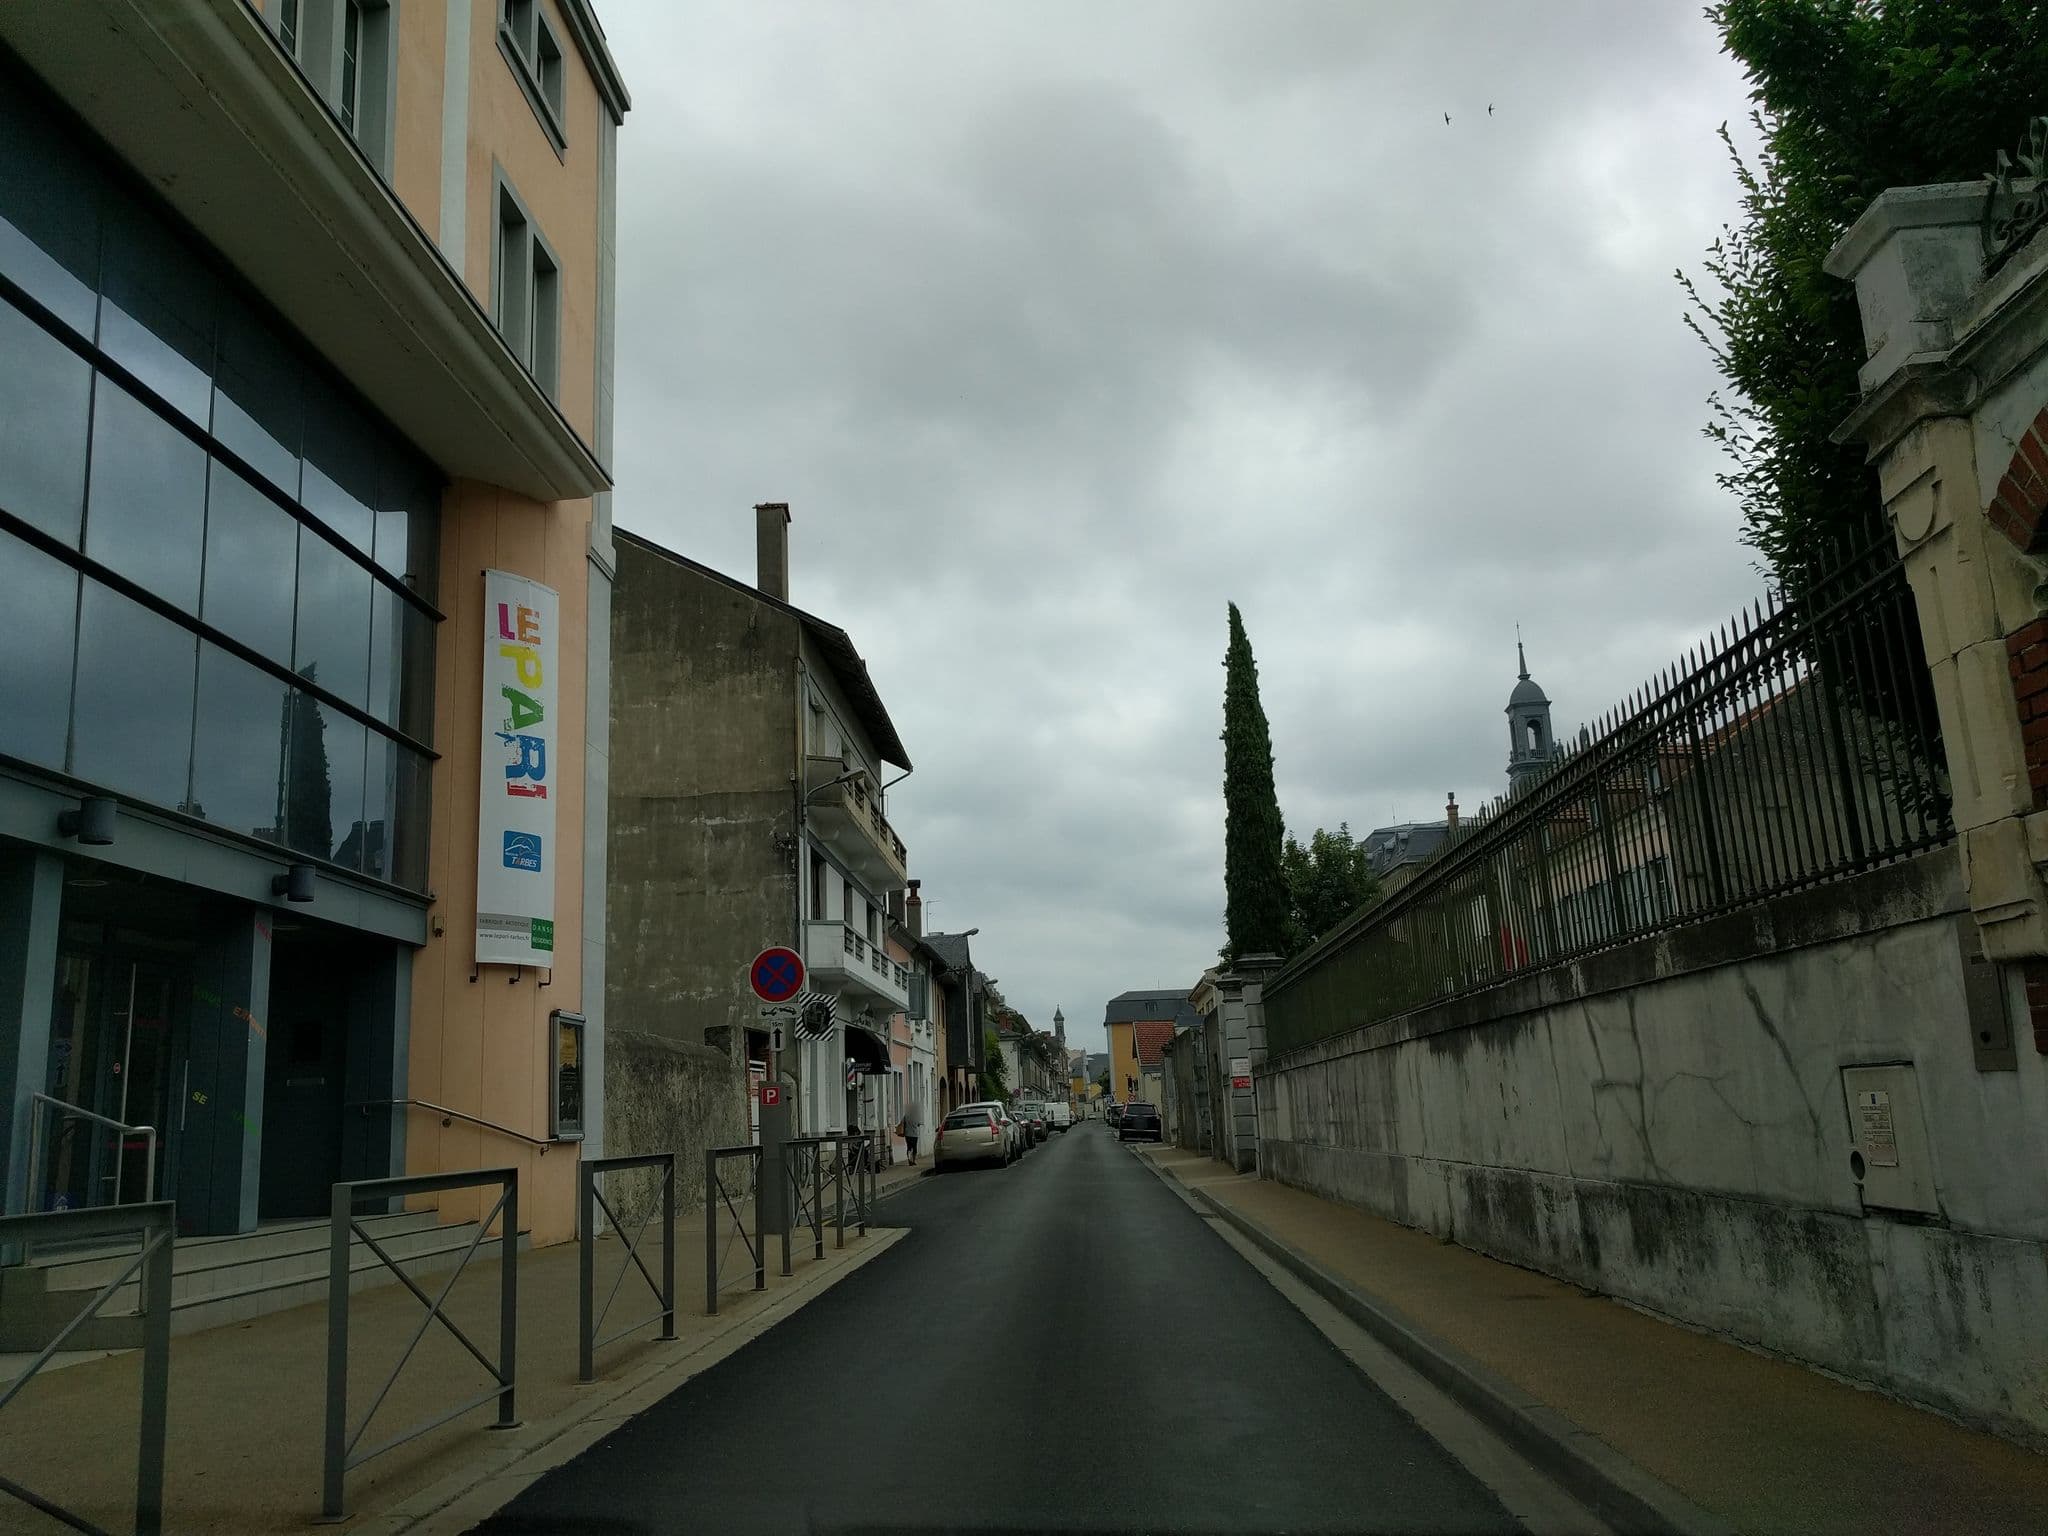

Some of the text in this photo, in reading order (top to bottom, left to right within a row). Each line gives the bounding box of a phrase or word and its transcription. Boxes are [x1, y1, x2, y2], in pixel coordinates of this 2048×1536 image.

[498, 603, 541, 645] LE
[511, 857, 537, 868] TARBES
[192, 1091, 208, 1105] SE
[766, 1089, 776, 1104] P
